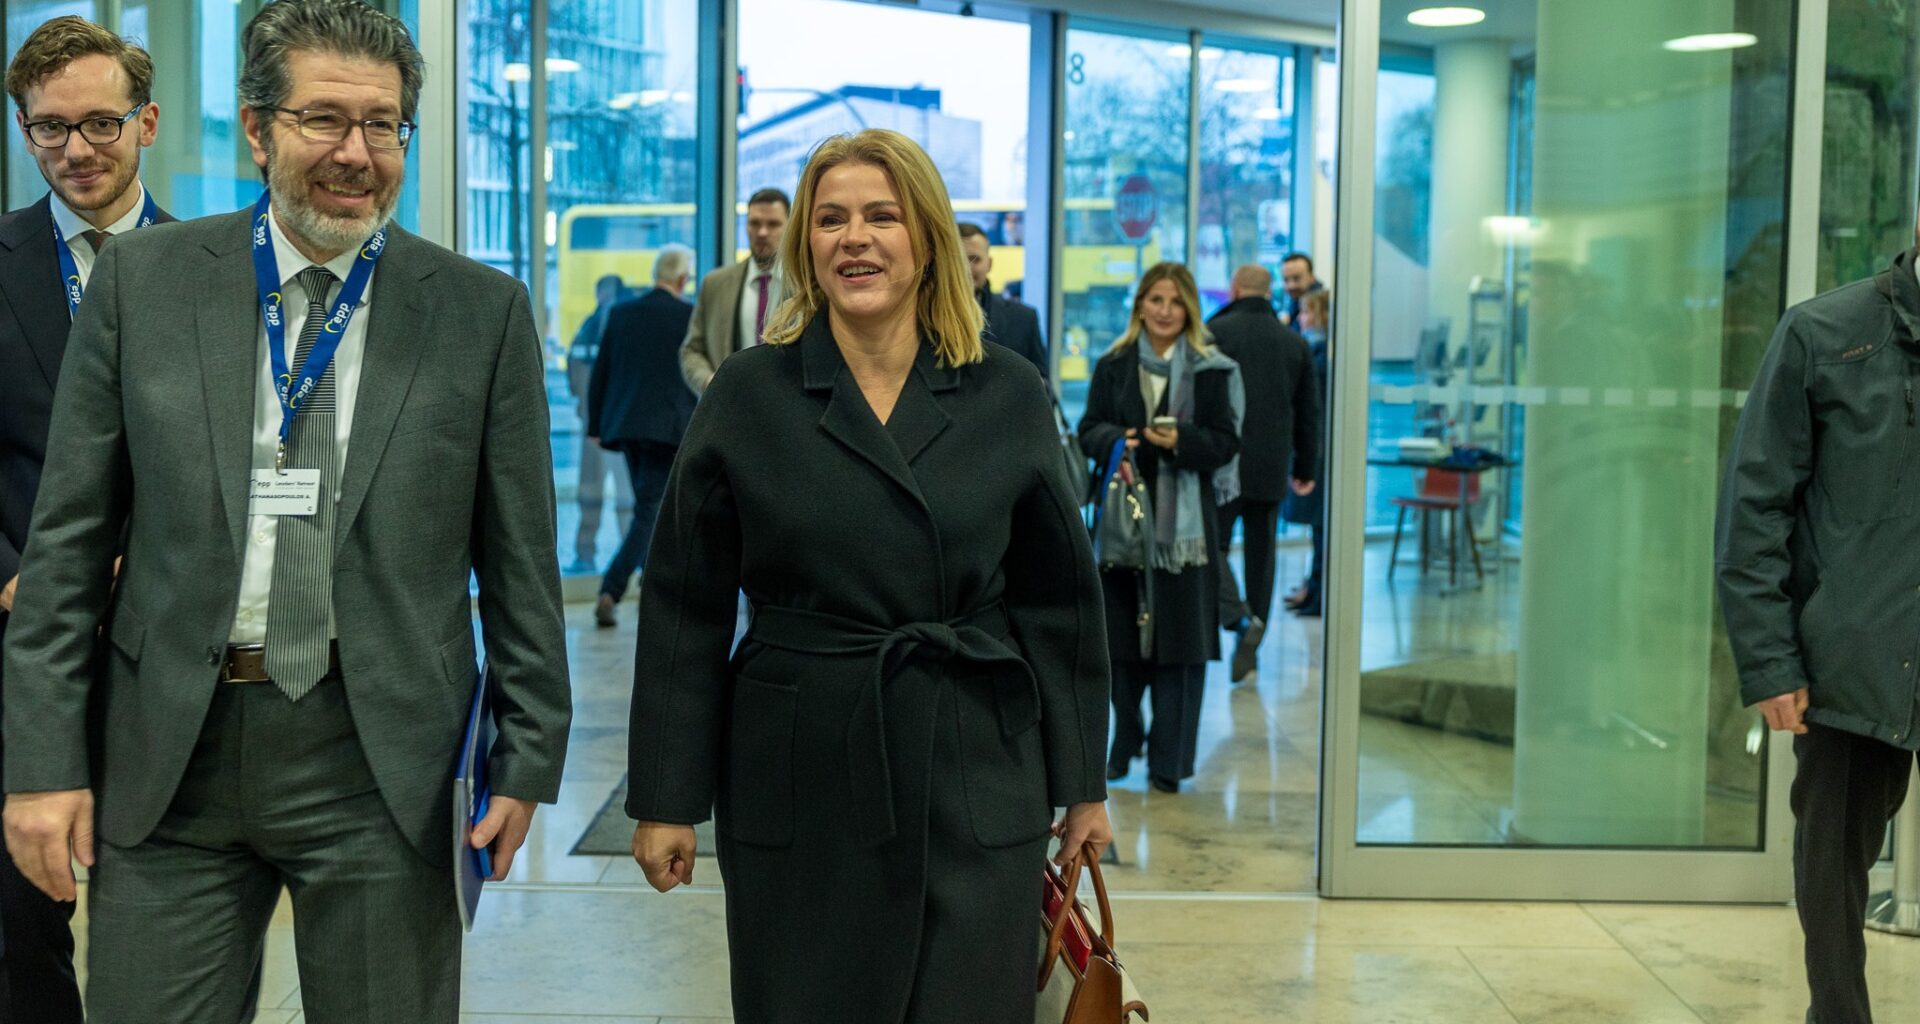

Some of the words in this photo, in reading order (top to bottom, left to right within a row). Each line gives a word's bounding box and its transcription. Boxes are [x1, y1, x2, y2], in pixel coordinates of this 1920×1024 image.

[255, 225, 266, 246] epp
[370, 231, 385, 251] epp
[70, 284, 81, 304] epp
[267, 304, 280, 326] epp
[333, 302, 350, 324] epp
[297, 377, 312, 398] epp
